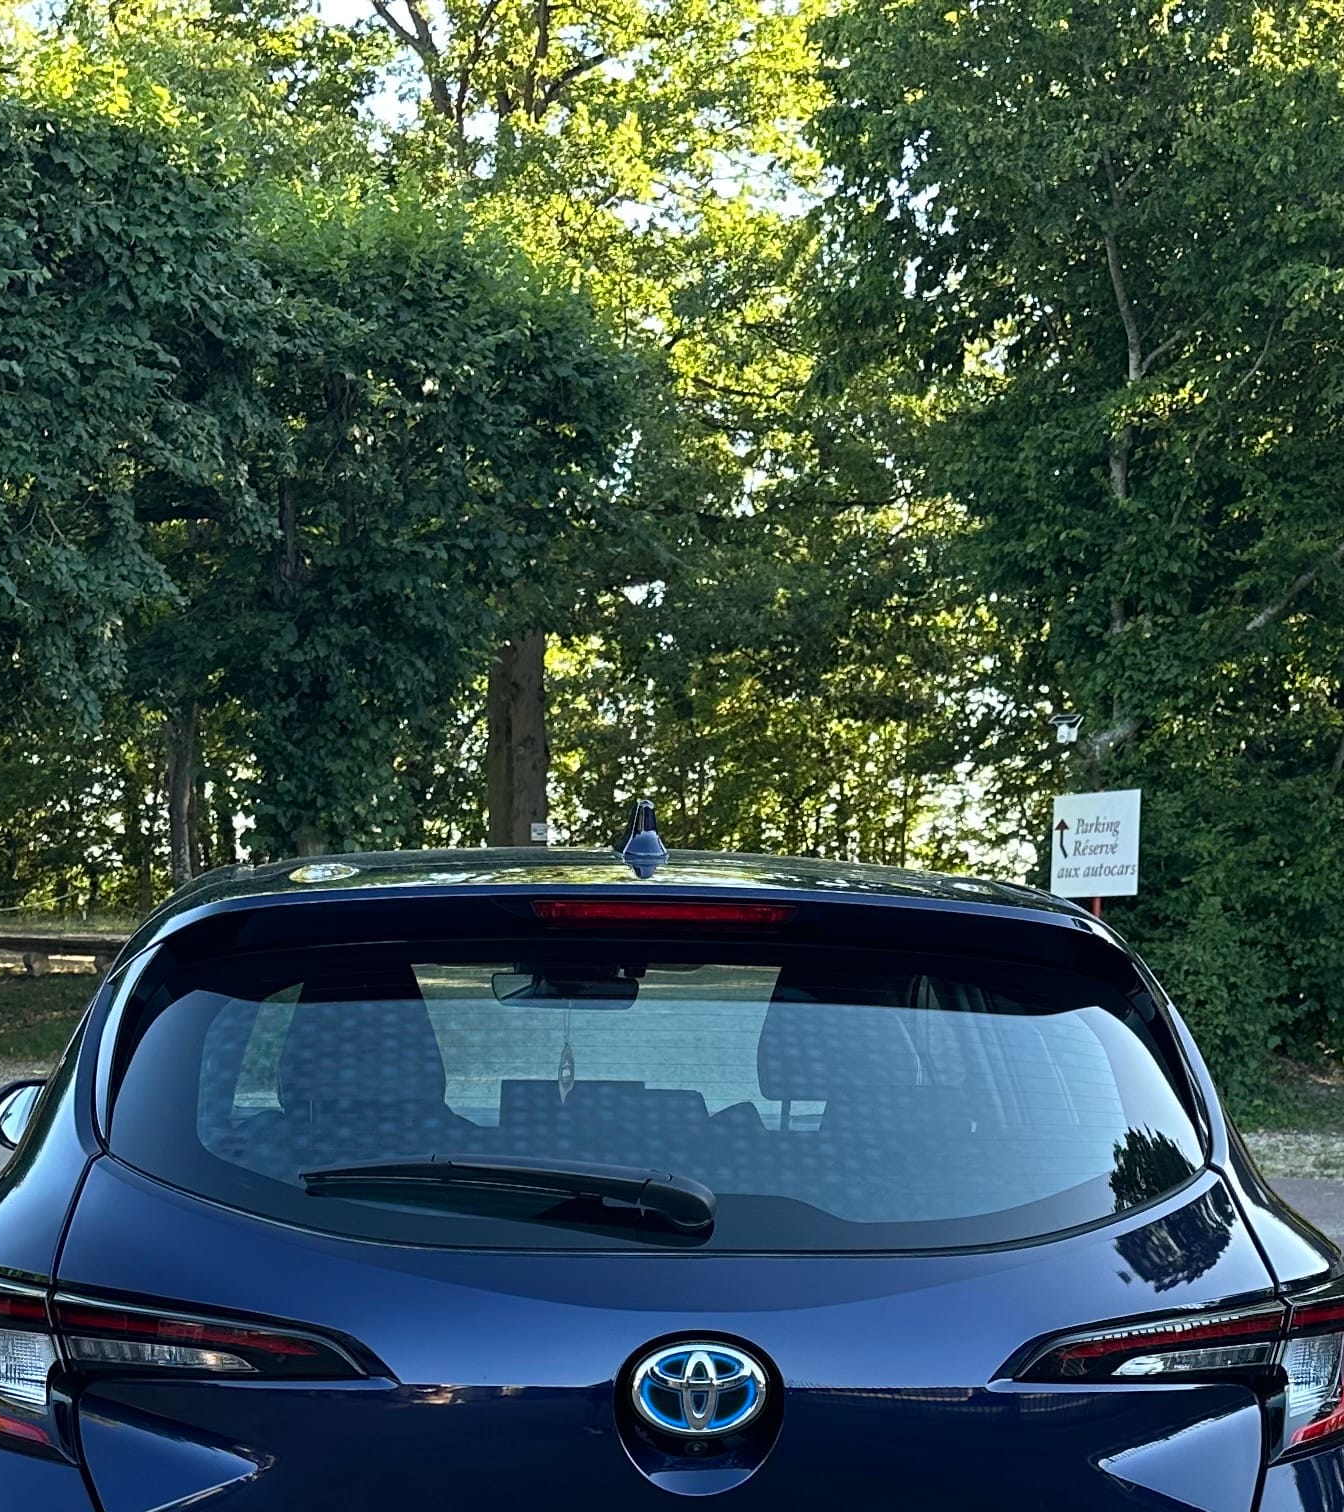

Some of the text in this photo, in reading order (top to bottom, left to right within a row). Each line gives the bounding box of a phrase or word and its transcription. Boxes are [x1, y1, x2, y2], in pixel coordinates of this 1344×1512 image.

[1074, 816, 1121, 837] Parking
[1072, 838, 1119, 857] Réservé
[1056, 863, 1136, 879] aux autocars
